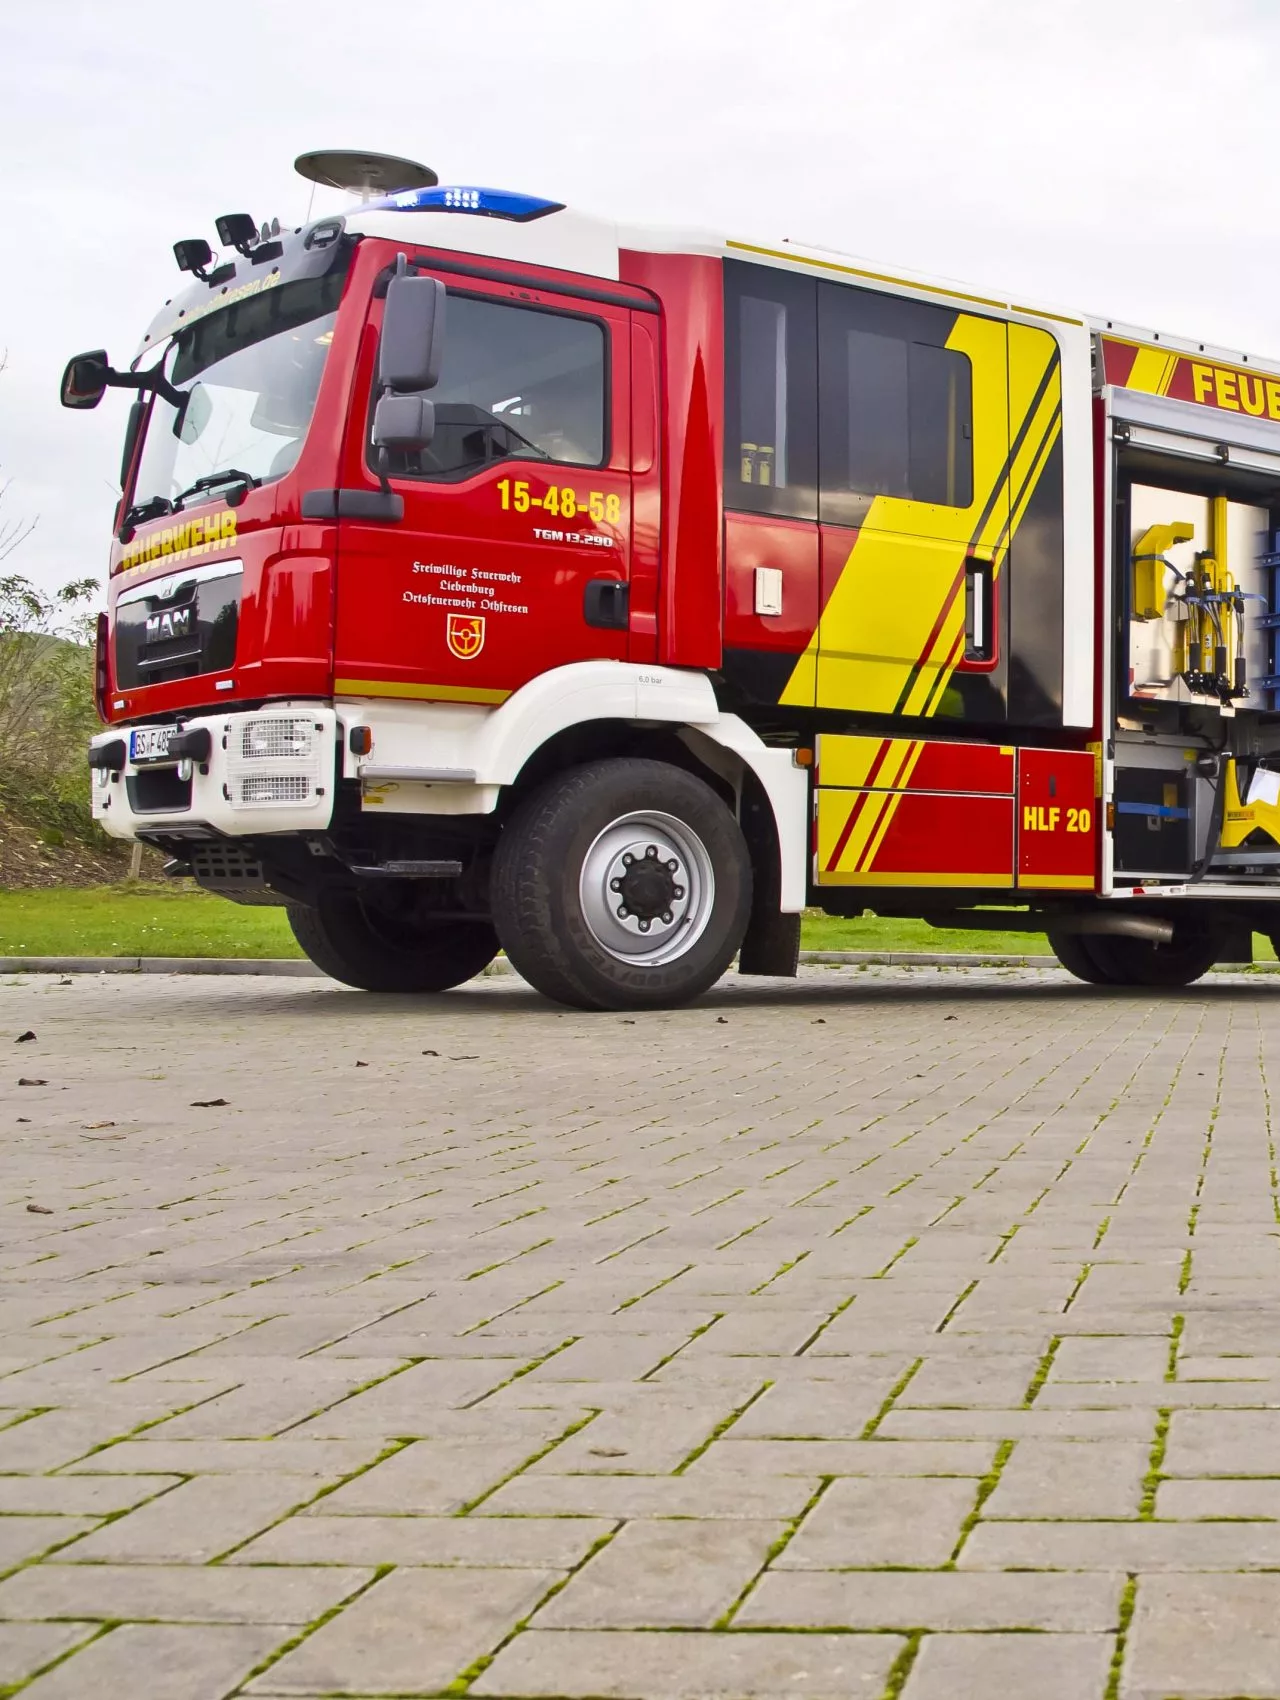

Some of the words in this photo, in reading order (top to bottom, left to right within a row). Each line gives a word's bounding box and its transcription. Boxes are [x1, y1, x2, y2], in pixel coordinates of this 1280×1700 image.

[497, 479, 621, 524] 15-48-58
[122, 510, 238, 579] FEUERWEHR
[533, 528, 564, 542] TGM
[565, 532, 614, 547] 13.290
[412, 561, 468, 578] Freiwillige
[471, 568, 522, 584] Feuerwehr
[440, 579, 495, 597] Liebenburg
[402, 591, 477, 609] Ortsfeuerwehr
[480, 599, 529, 614] Othfresen
[146, 609, 190, 644] MAN
[136, 734, 146, 754] GS
[1023, 806, 1060, 831] HLF
[1066, 808, 1091, 833] 20
